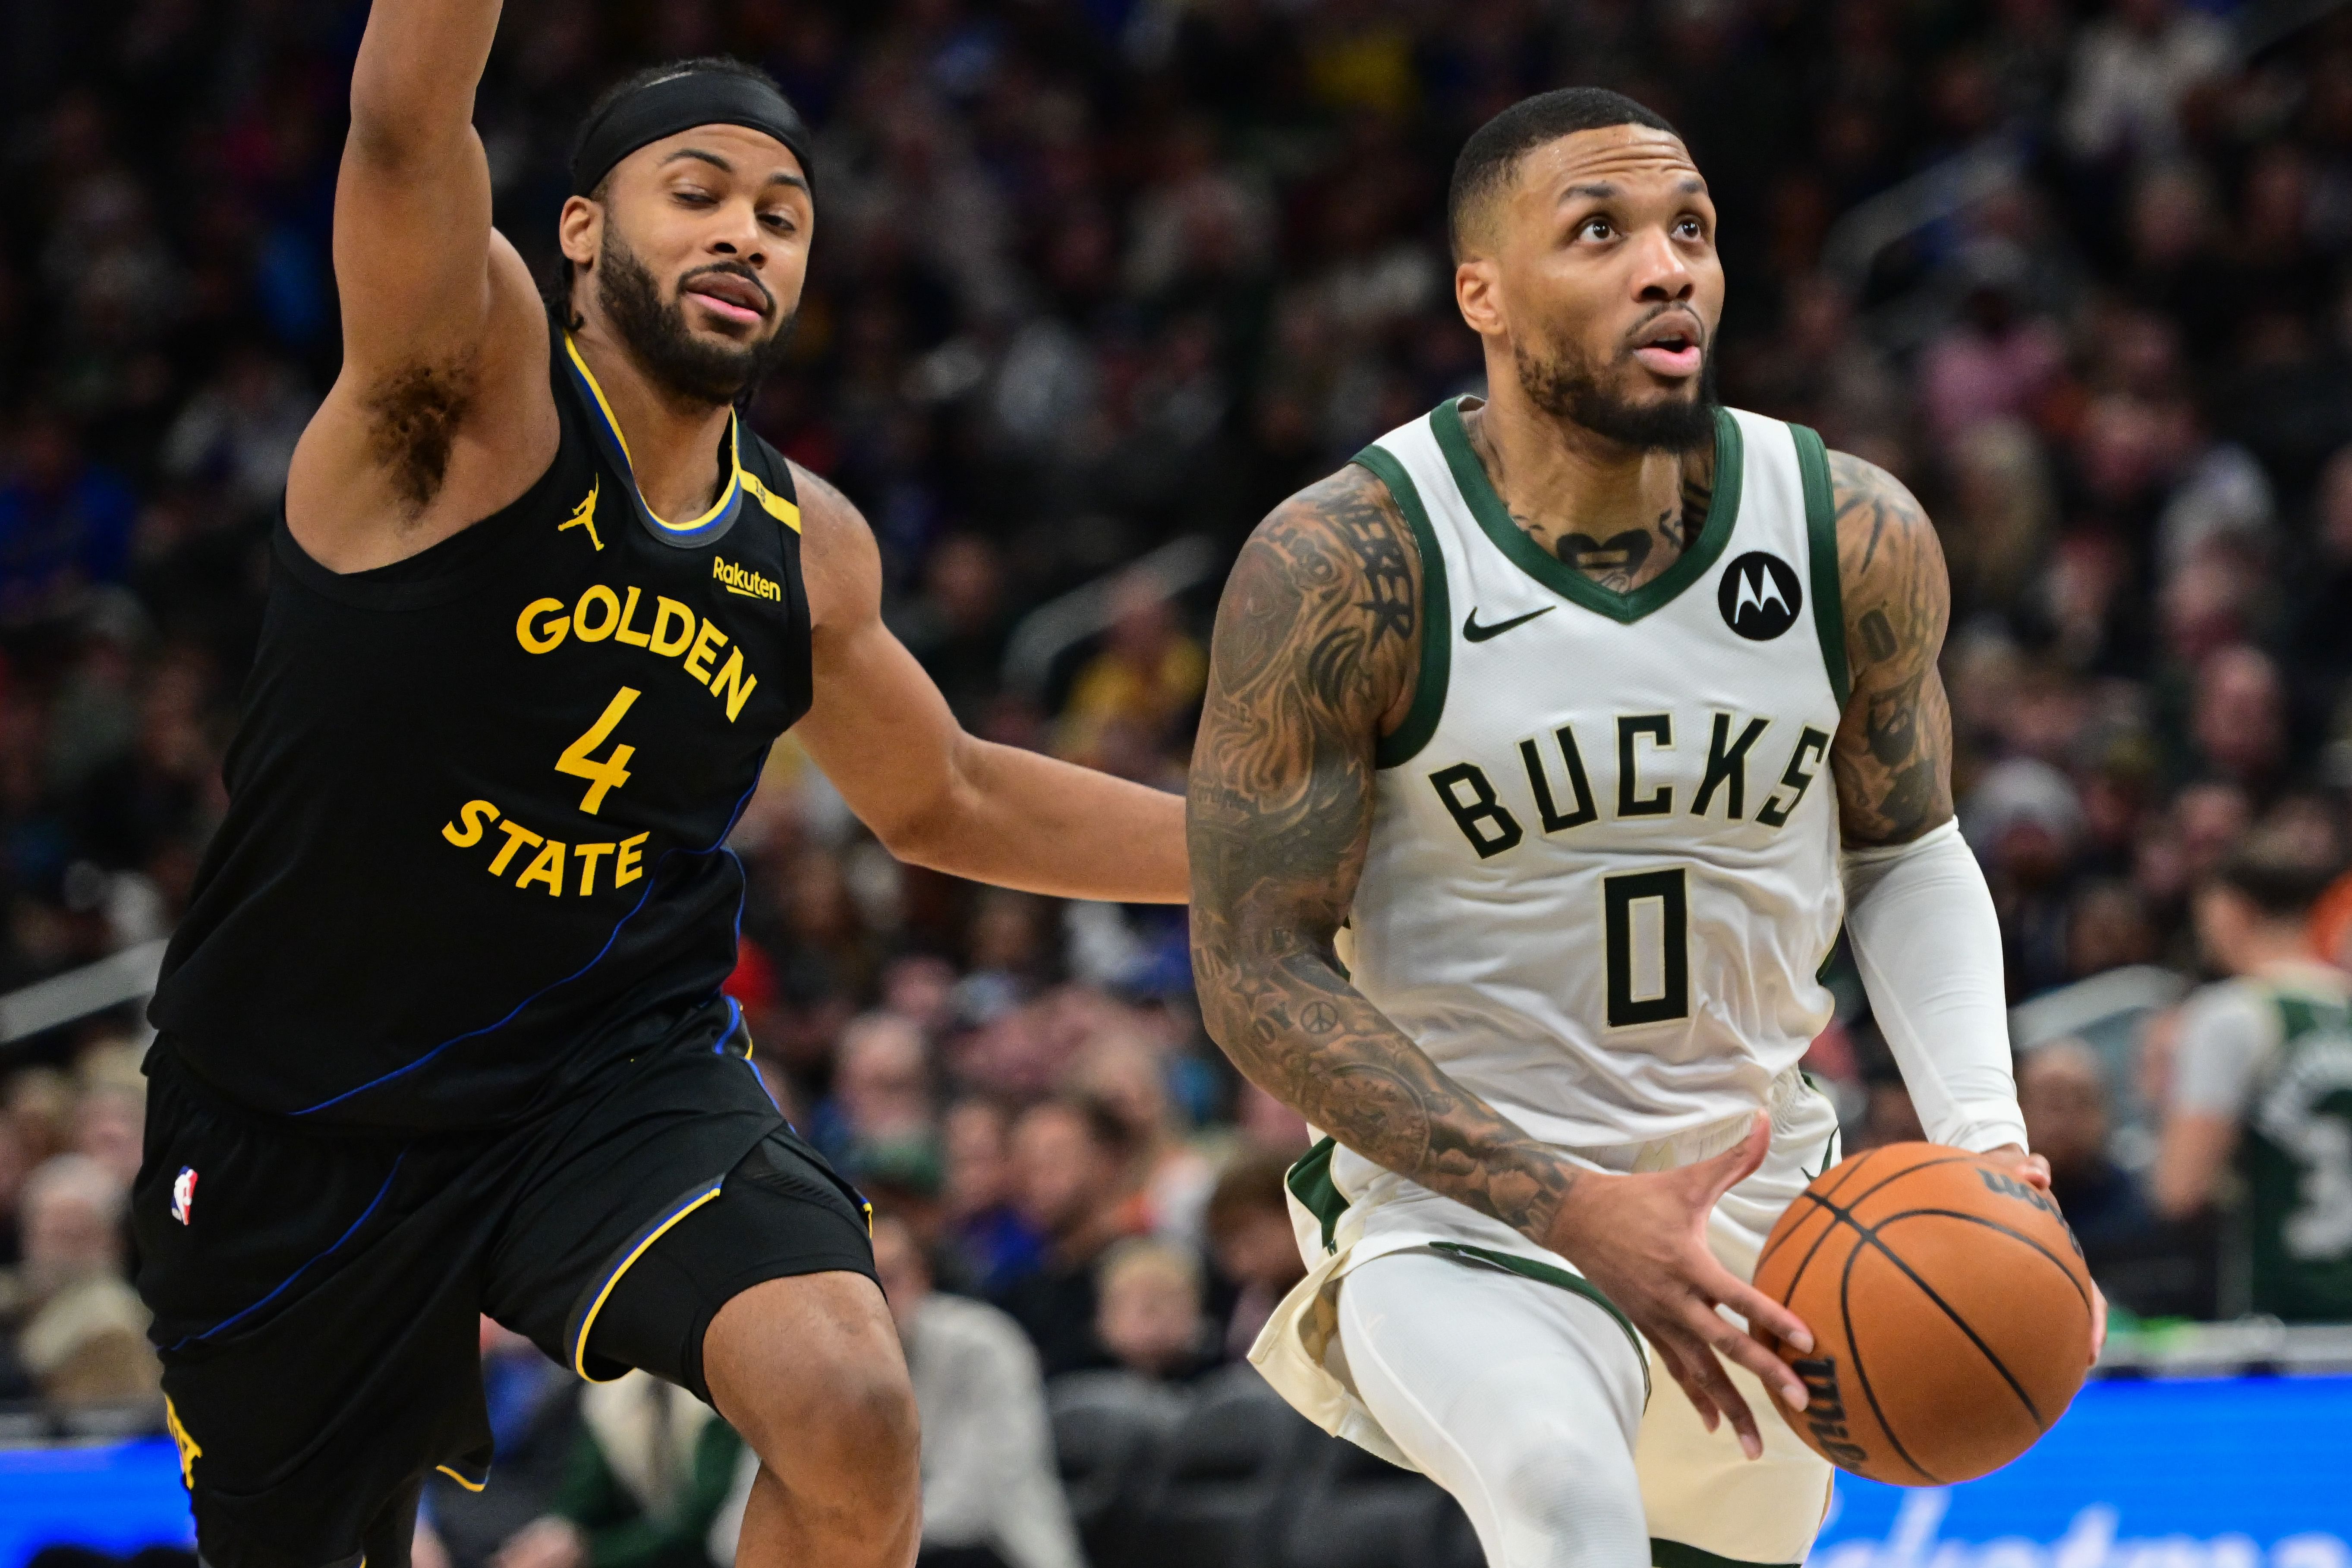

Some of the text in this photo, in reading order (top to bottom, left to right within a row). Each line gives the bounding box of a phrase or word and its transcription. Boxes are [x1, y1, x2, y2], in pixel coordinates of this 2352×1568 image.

[713, 556, 781, 602] Rakuten
[516, 584, 758, 723] GOLDEN
[554, 685, 642, 815] 4
[1426, 712, 1832, 861] BUCKS
[441, 800, 650, 897] STATE
[1600, 866, 1691, 1030] 0
